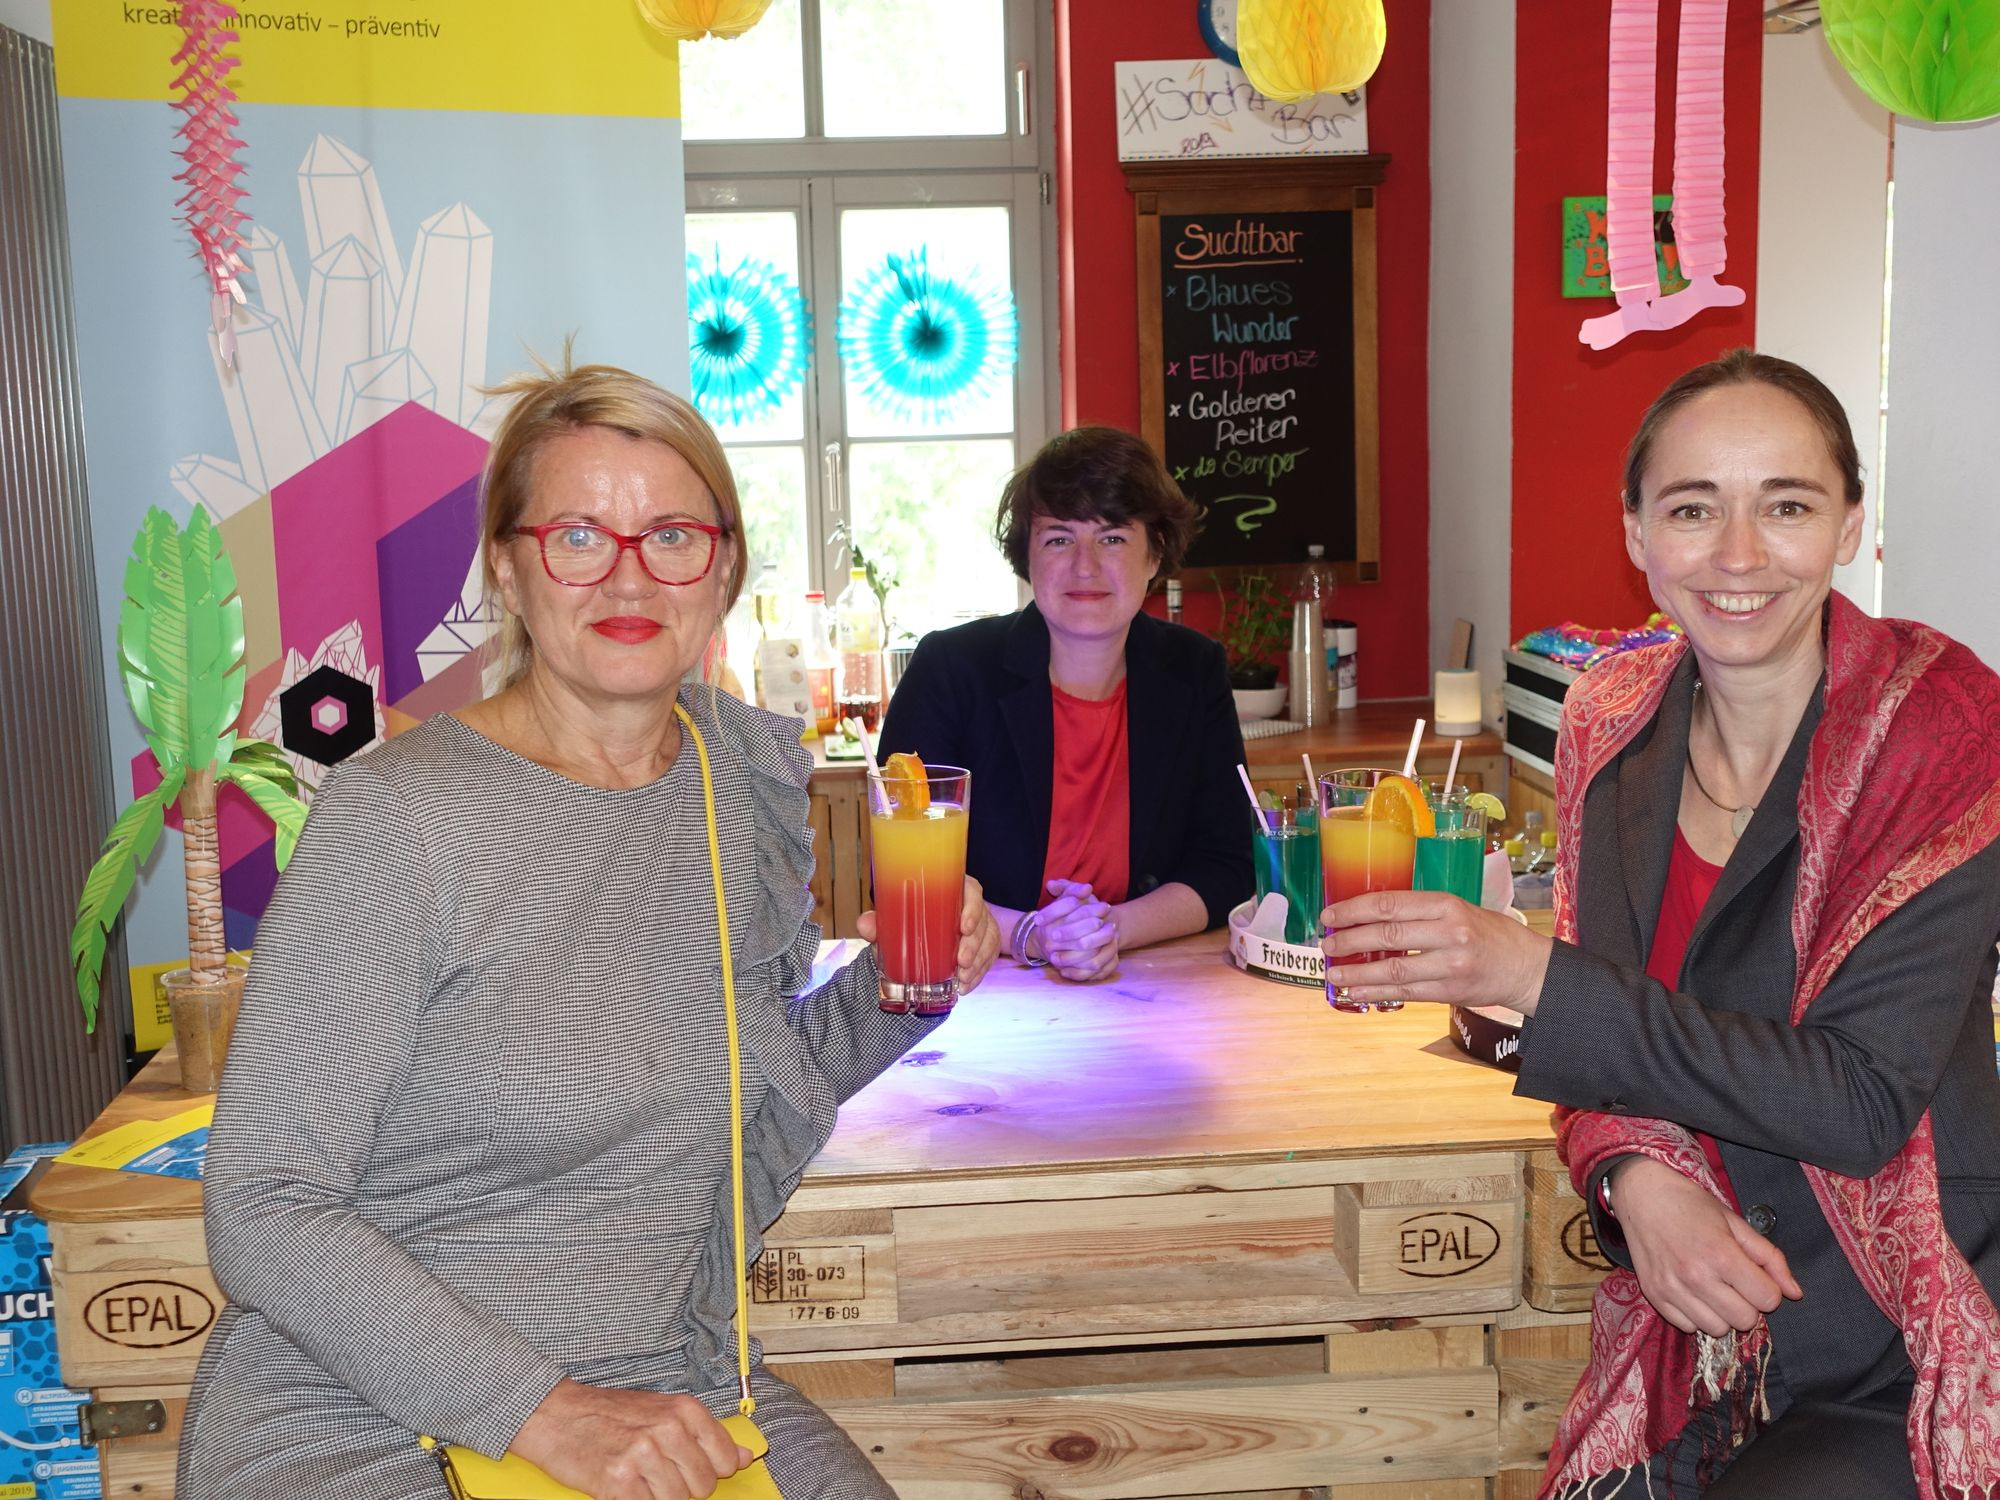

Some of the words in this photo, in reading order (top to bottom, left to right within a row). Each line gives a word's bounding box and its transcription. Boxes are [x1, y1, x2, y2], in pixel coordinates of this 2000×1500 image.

[123, 2, 182, 25] kreat
[346, 16, 440, 38] präventiv
[1271, 103, 1356, 145] Bar
[1175, 219, 1304, 261] Suchtbar
[1186, 273, 1294, 311] Blaues
[1211, 312, 1299, 344] Wunder
[1190, 350, 1319, 393] Elbflorenz
[1189, 388, 1296, 420] Goldener
[1215, 416, 1299, 451] Reiter
[1222, 448, 1310, 487] Semper
[1261, 942, 1325, 976] Freiberge
[787, 1251, 805, 1266] PL
[1401, 1226, 1483, 1263] EPAL
[789, 1284, 809, 1298] HT
[105, 1295, 196, 1334] EPAL
[9, 1486, 32, 1496] 2019
